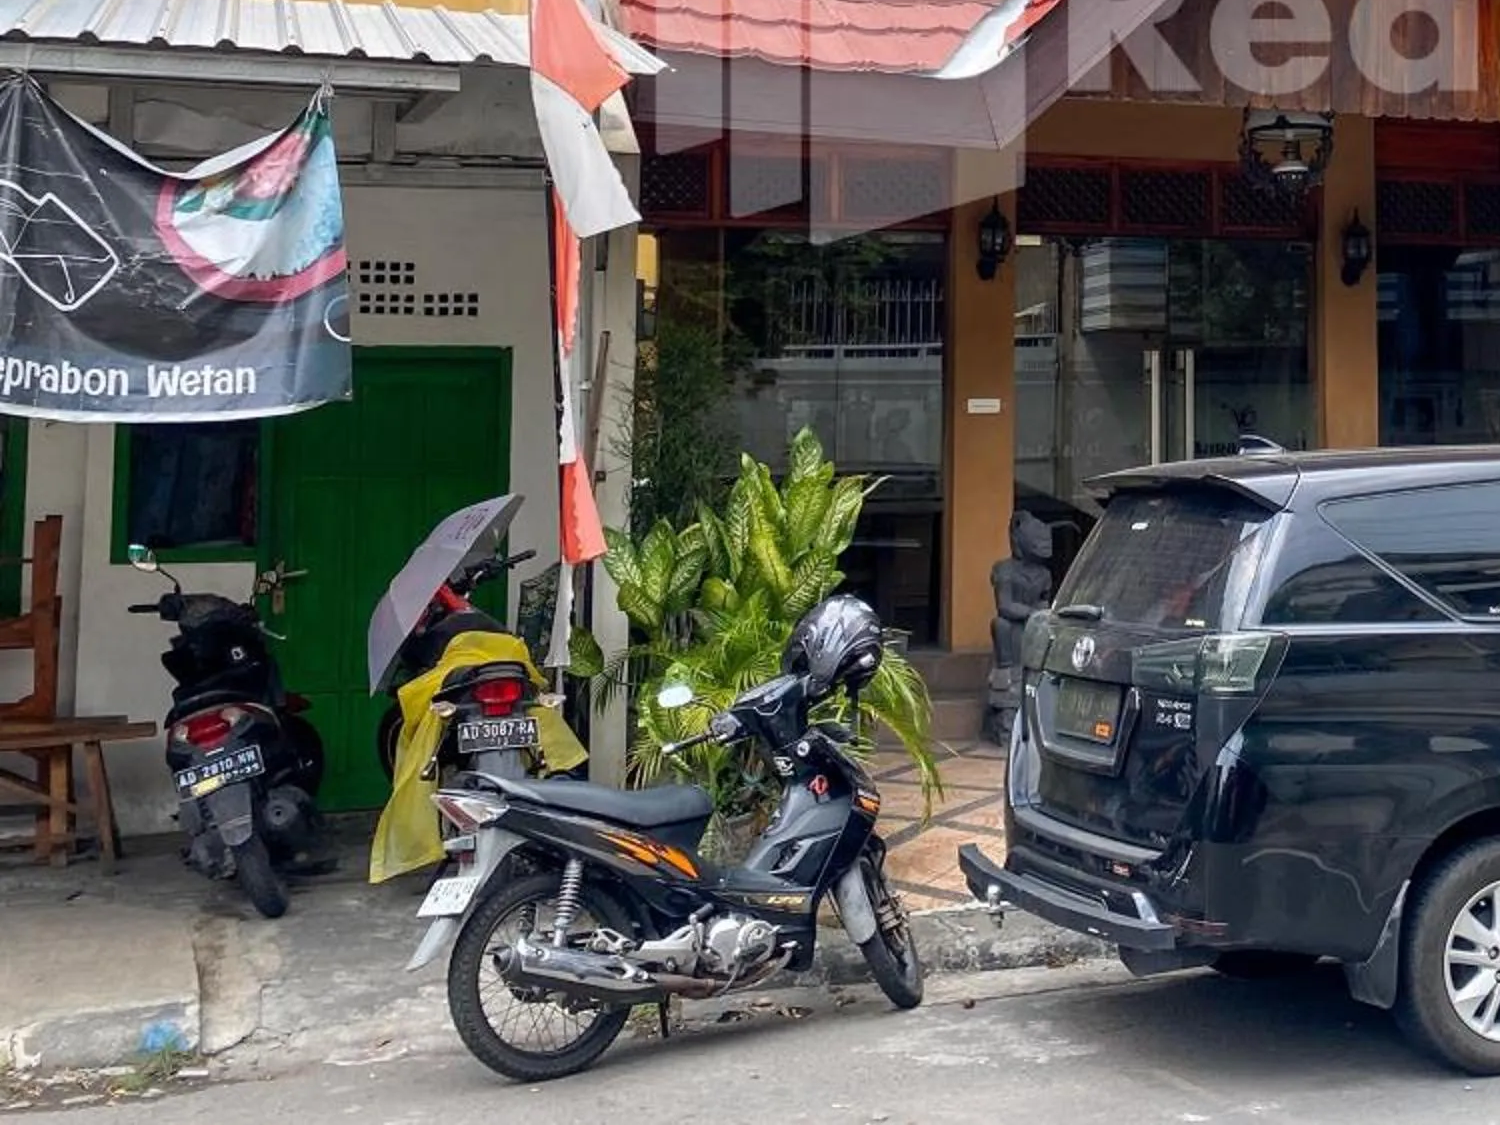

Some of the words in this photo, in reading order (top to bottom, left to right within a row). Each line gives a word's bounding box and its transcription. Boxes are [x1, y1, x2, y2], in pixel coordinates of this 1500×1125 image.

[0, 356, 129, 396] prabon
[147, 363, 256, 398] Wetan
[460, 725, 479, 740] AD
[179, 771, 198, 788] AD
